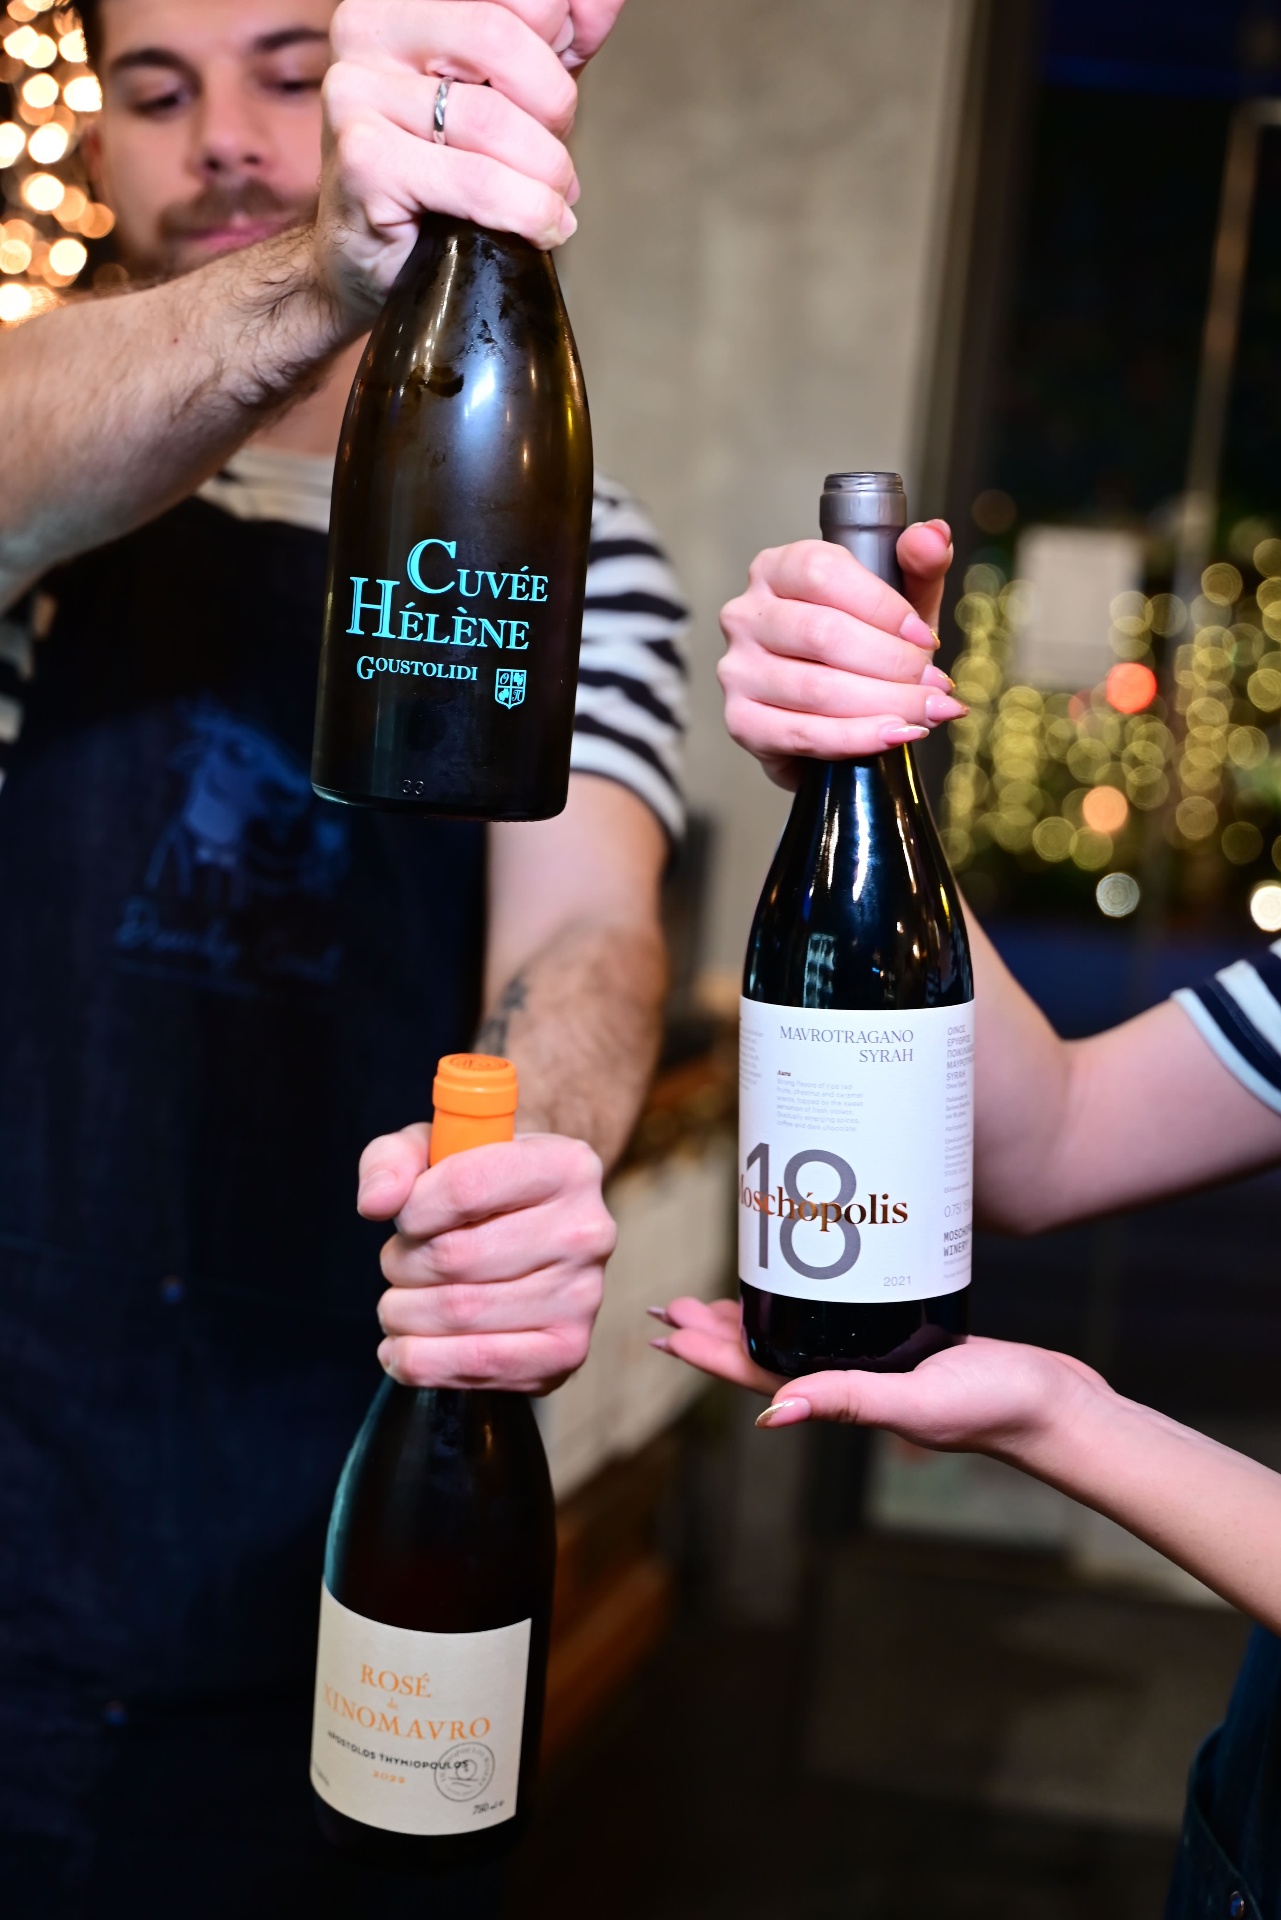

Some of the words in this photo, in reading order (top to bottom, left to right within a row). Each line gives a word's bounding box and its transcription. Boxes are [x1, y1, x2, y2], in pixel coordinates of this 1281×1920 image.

[406, 538, 549, 602] CUVÉE
[345, 576, 530, 650] HÉLÈNE
[356, 655, 478, 681] GOUSTOLIDI
[780, 1025, 914, 1044] MAVROTRAGANO
[859, 1048, 914, 1063] SYRAH
[746, 1142, 861, 1281] 18
[883, 1276, 912, 1287] 2021
[361, 1663, 432, 1698] ROSÉ
